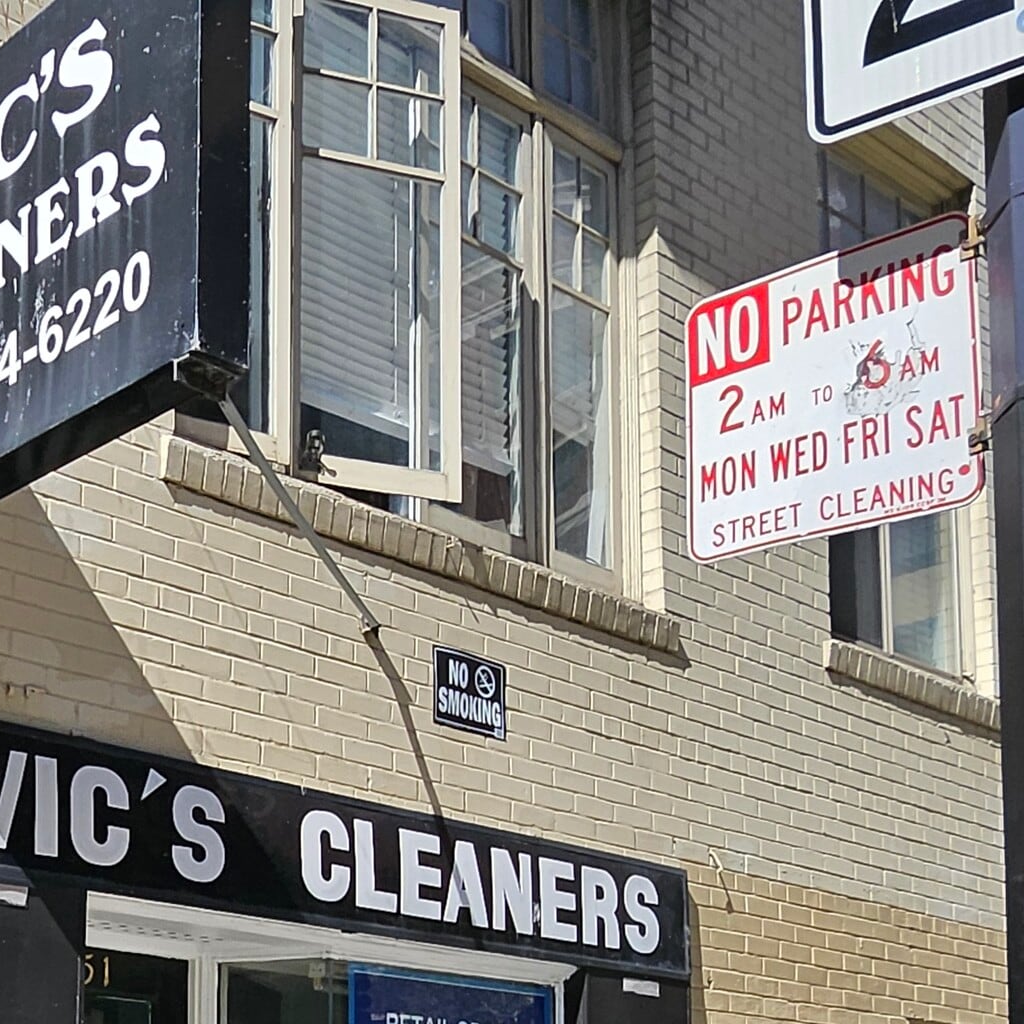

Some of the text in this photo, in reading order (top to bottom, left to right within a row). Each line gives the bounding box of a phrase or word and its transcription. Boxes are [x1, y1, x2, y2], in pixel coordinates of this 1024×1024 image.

[697, 244, 955, 376] NO PARKING
[812, 385, 833, 406] TO
[700, 394, 965, 503] MON WED FRI SAT
[712, 468, 955, 548] STREET CLEANING
[438, 686, 501, 727] SMOKING
[449, 659, 468, 689] NO
[301, 810, 661, 955] CLEANERS
